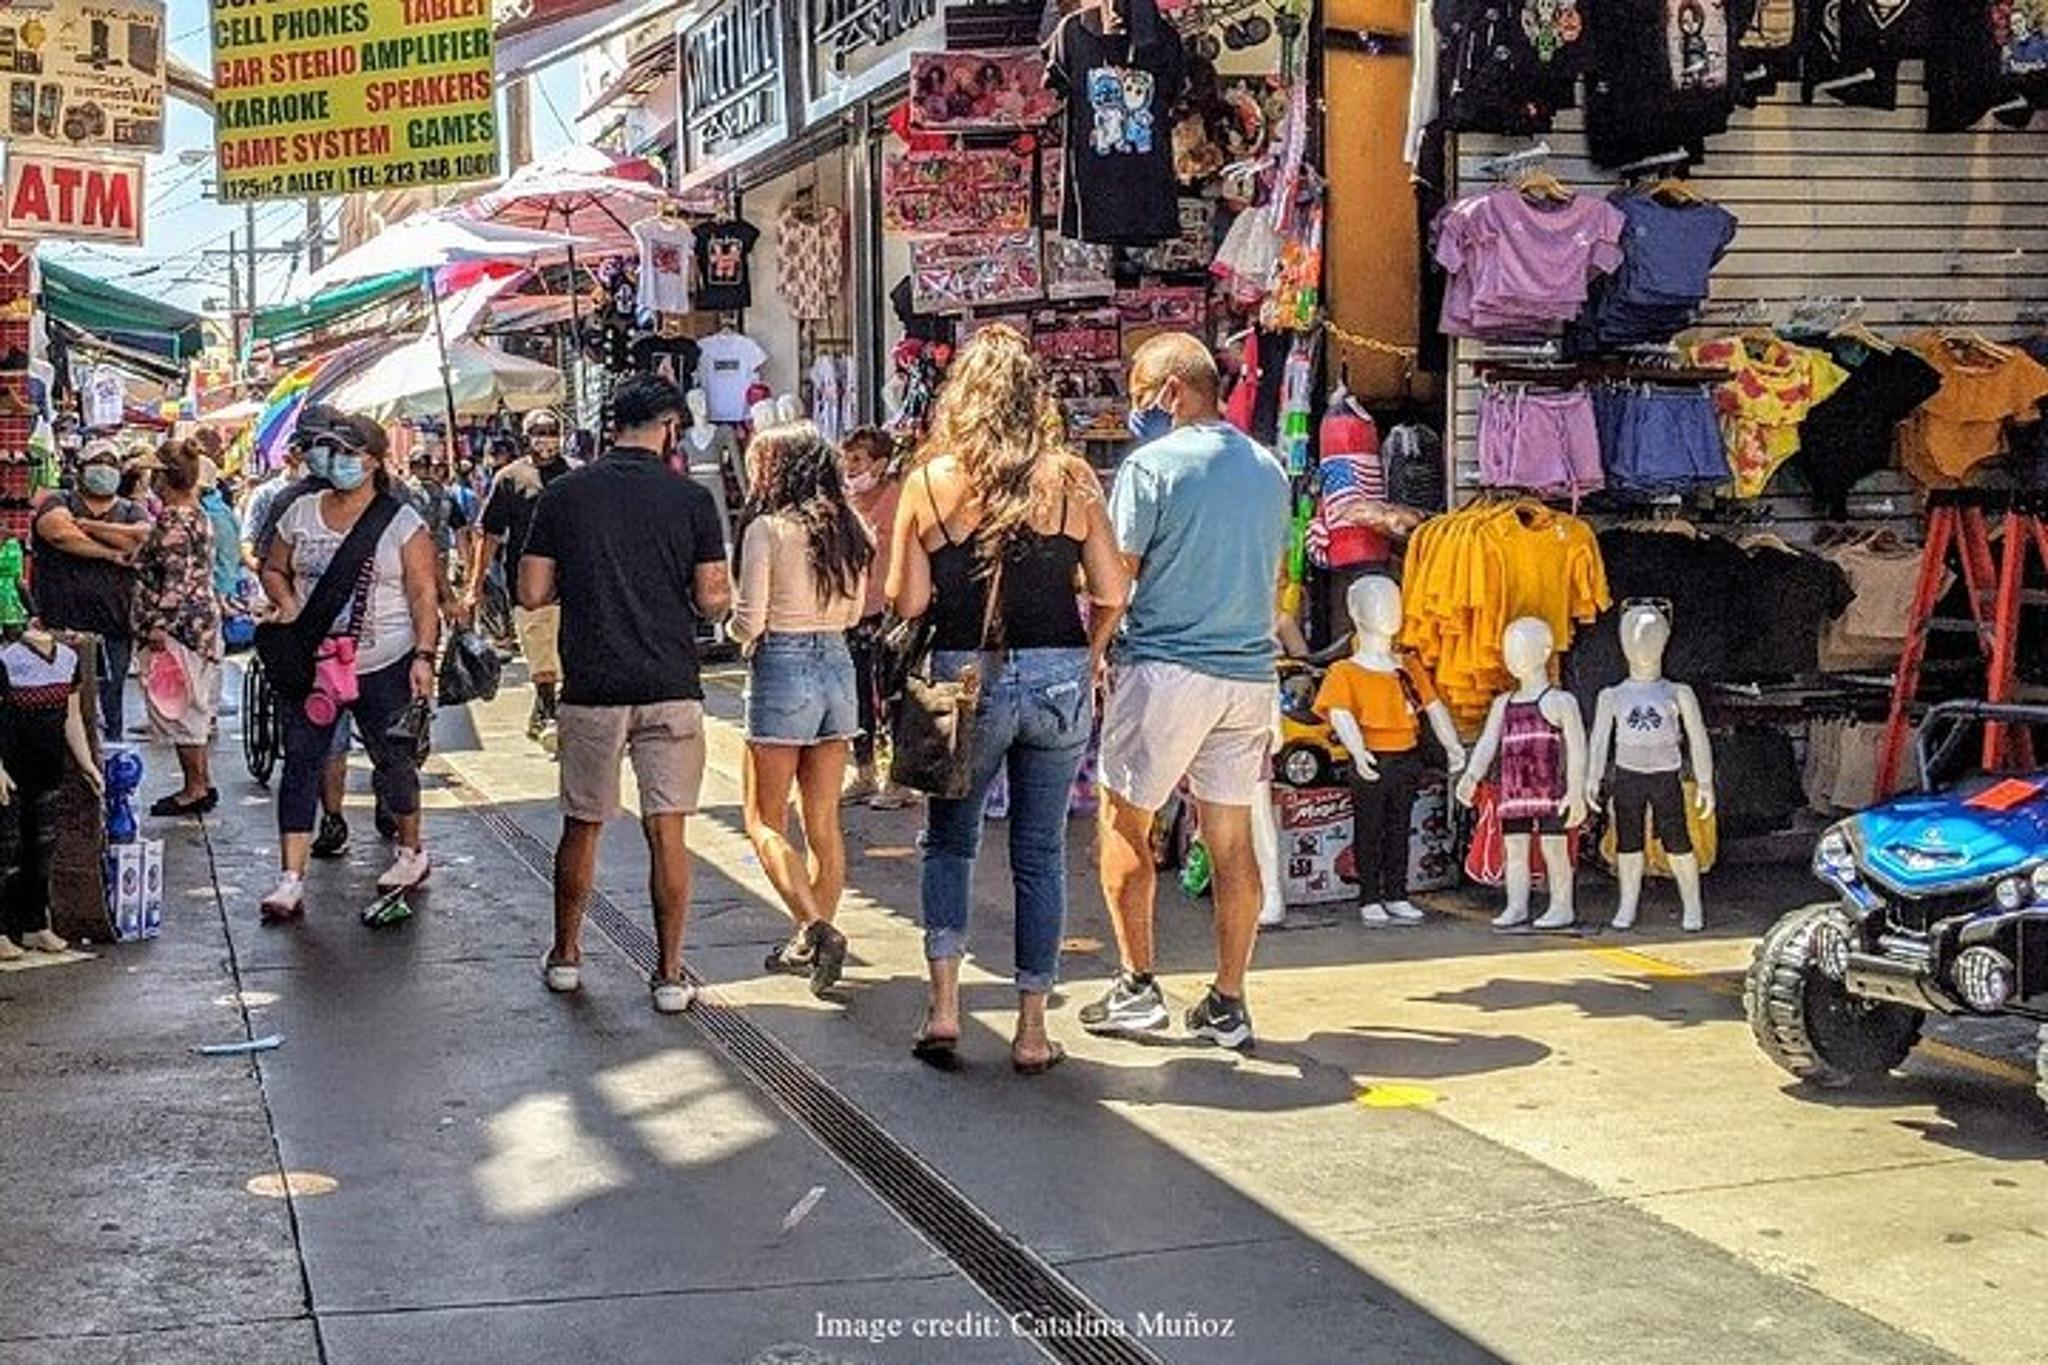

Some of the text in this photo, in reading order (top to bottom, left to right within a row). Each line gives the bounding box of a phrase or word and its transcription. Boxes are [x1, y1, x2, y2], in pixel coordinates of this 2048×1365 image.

[215, 2, 369, 49] CELL PHONES
[401, 0, 485, 26] TABLET
[215, 45, 356, 89] CAR STERIO
[361, 28, 490, 72] AMPLIFIER
[216, 90, 330, 128] KARAOKE
[365, 70, 491, 114] SPEAKERS
[221, 124, 391, 171] GAME SYSTEM
[407, 111, 493, 149] GAMES
[10, 163, 133, 229] ATM
[287, 169, 334, 194] ALLEY
[383, 160, 416, 184] 213
